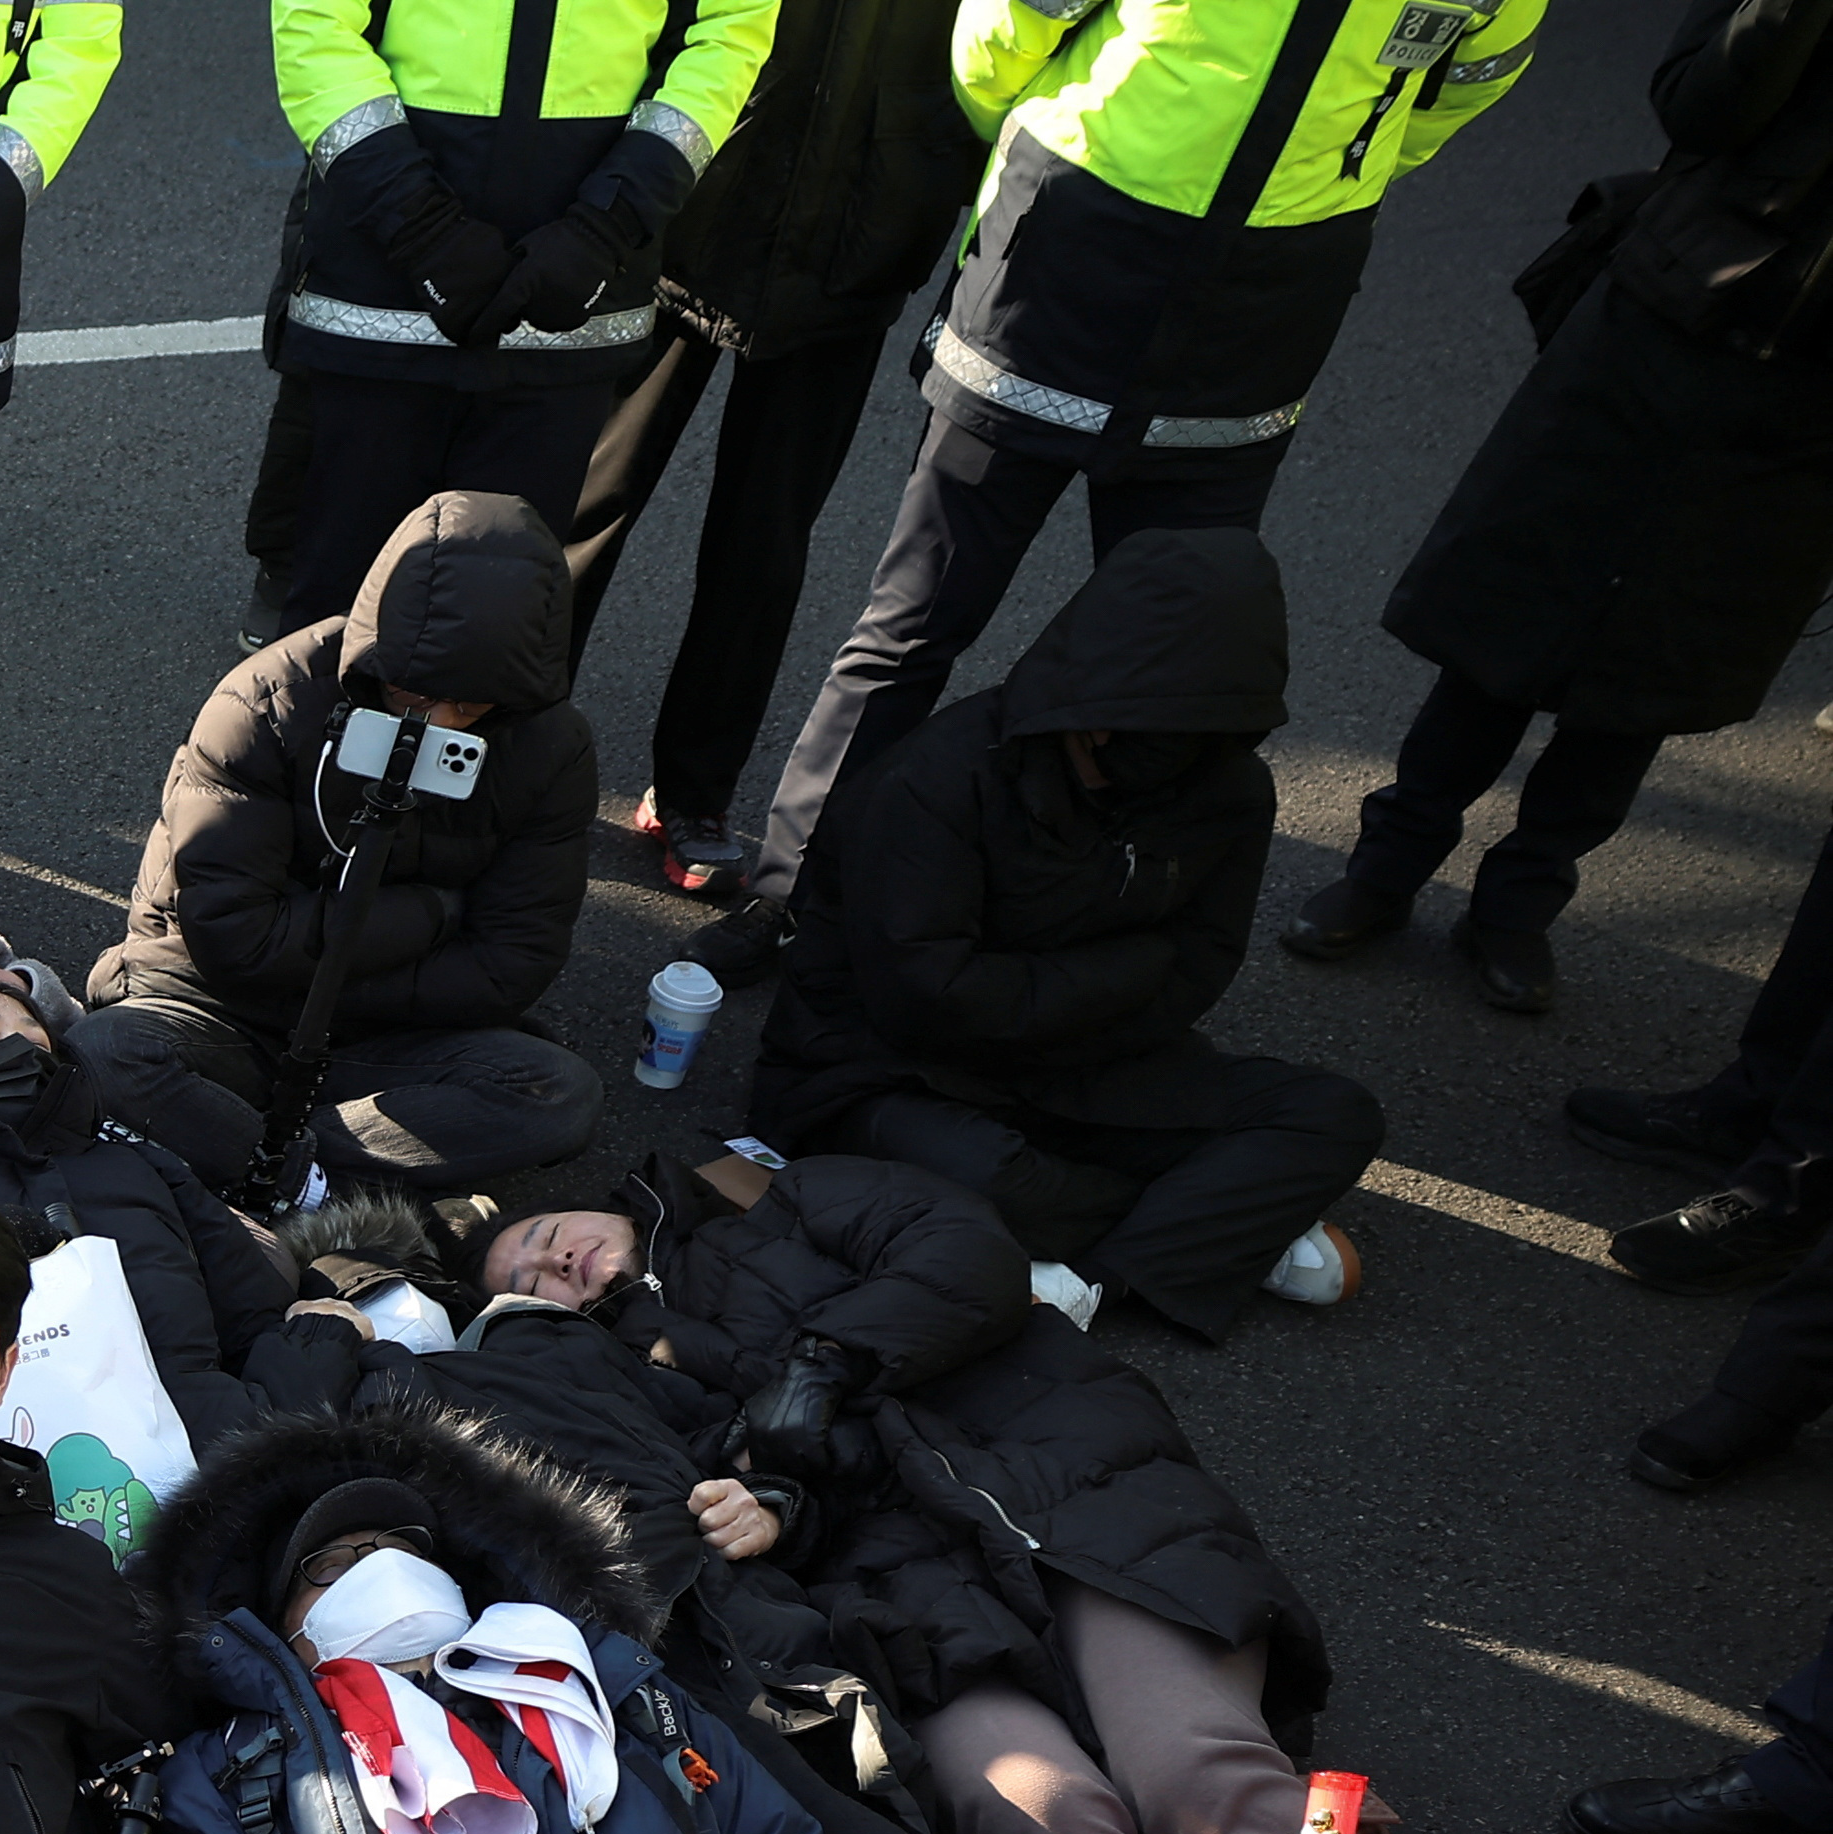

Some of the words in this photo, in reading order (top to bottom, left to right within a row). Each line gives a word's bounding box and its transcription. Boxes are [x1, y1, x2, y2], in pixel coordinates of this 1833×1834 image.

[423, 279, 447, 306] POLICE
[584, 279, 607, 310] POLICE
[654, 1689, 677, 1737] BackJo
